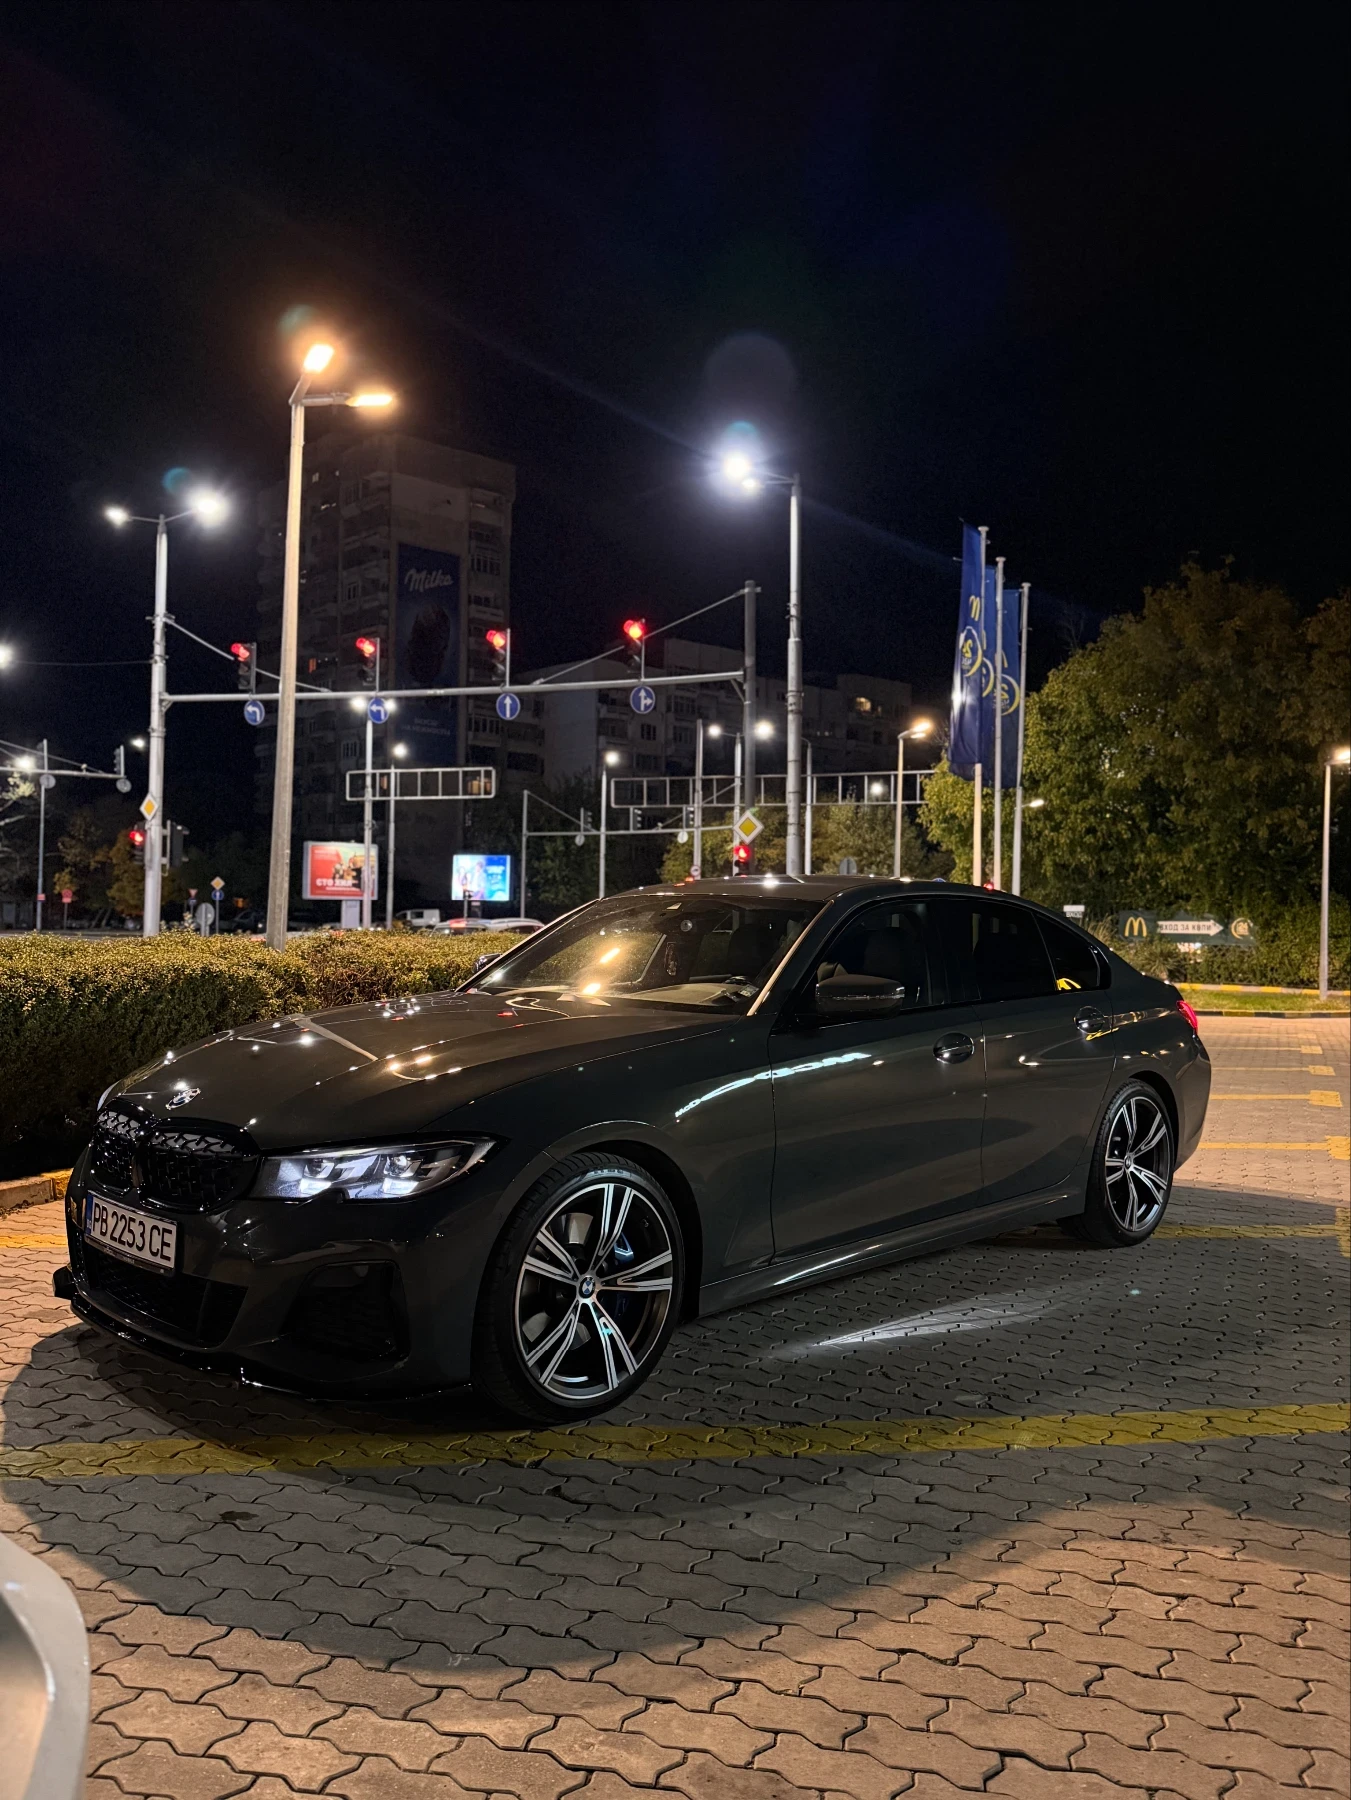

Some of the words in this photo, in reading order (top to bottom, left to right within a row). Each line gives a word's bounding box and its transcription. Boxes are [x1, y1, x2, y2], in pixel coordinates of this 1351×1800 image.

[404, 568, 454, 593] Milka
[1160, 923, 1178, 931] ВХОД
[1180, 923, 1190, 931] ЗА
[92, 1203, 108, 1237] PB
[109, 1210, 146, 1252] 2253
[149, 1225, 173, 1262] CE
